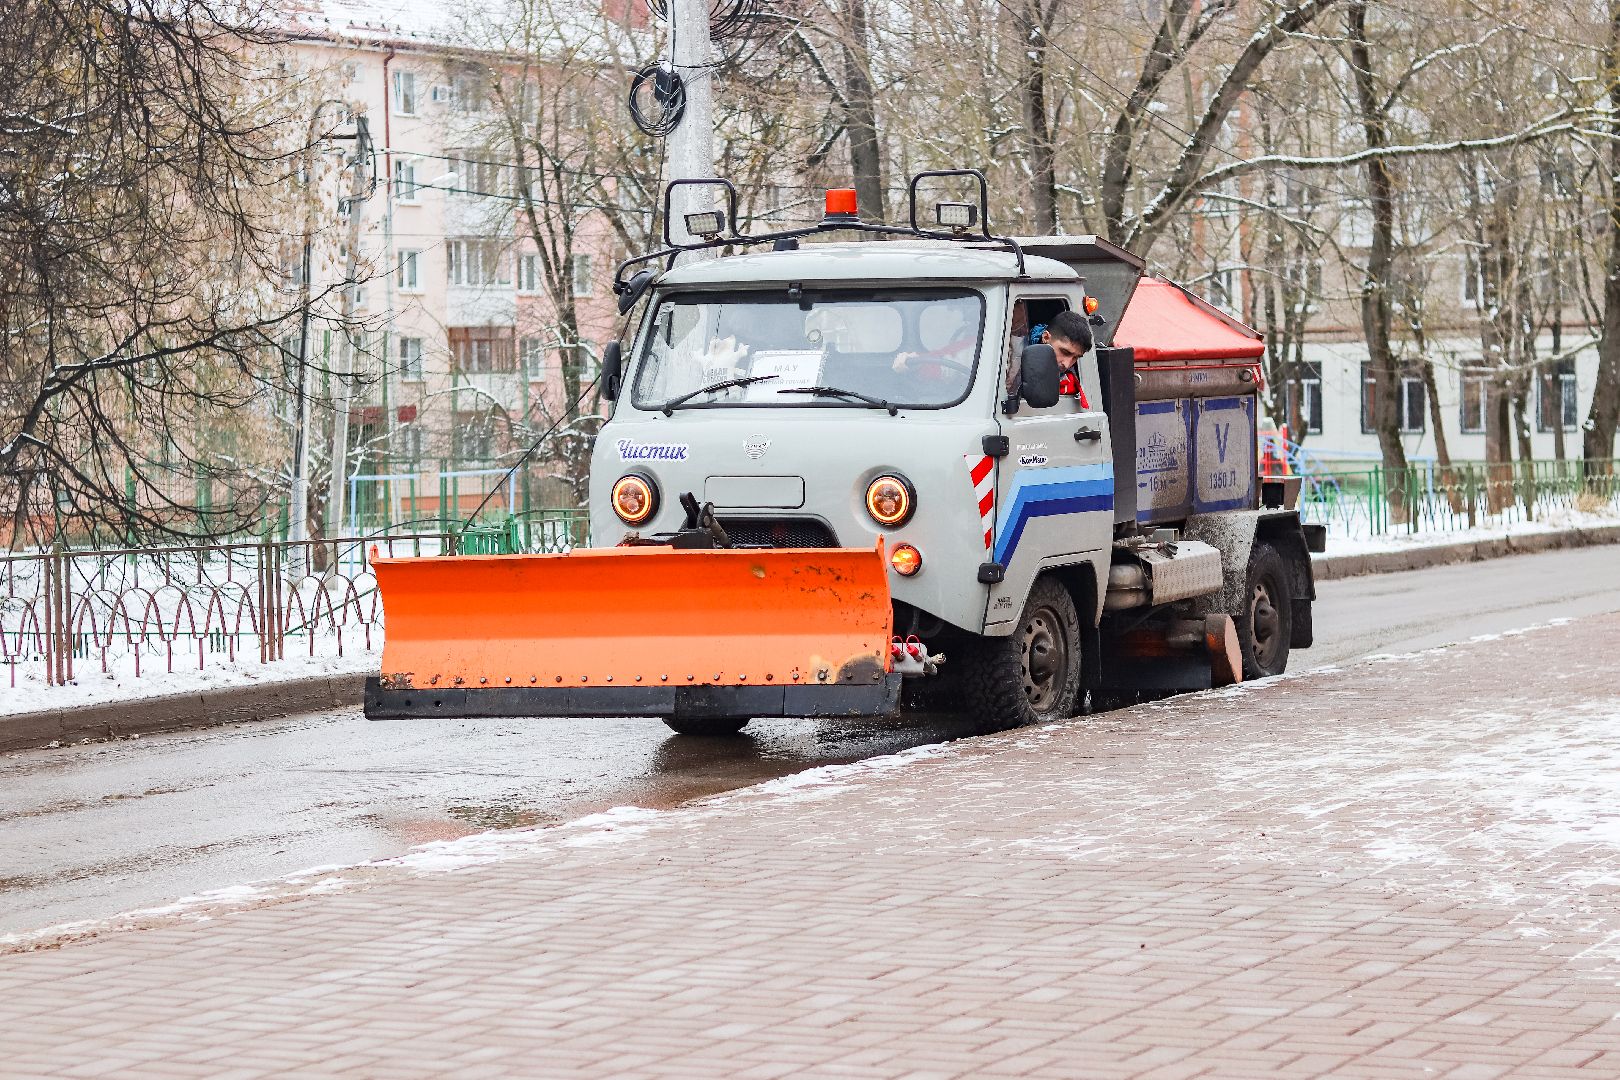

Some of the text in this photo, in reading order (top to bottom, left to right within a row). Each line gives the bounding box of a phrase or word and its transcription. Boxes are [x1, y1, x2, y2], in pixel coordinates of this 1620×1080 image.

[617, 439, 687, 460] Чистик
[1215, 422, 1230, 463] V
[1209, 471, 1227, 489] 1350
